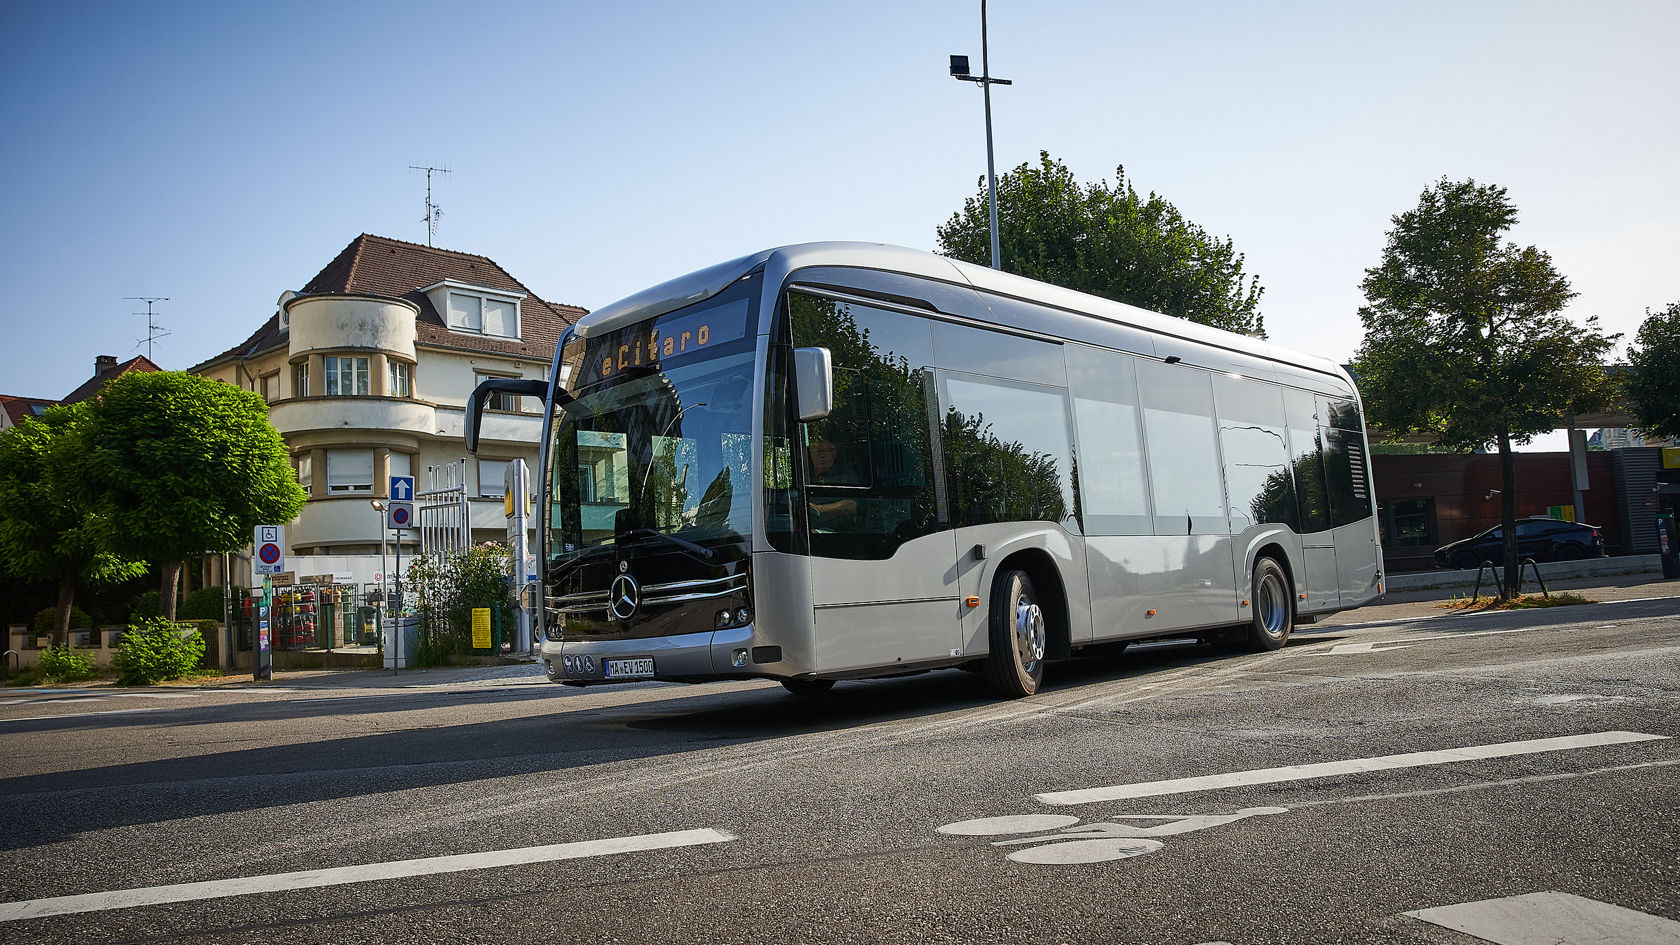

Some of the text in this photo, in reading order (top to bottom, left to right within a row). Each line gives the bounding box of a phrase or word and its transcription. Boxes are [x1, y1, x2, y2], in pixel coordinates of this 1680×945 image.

[602, 325, 710, 376] eCitaro
[624, 661, 633, 674] EV
[635, 660, 653, 673] 1500
